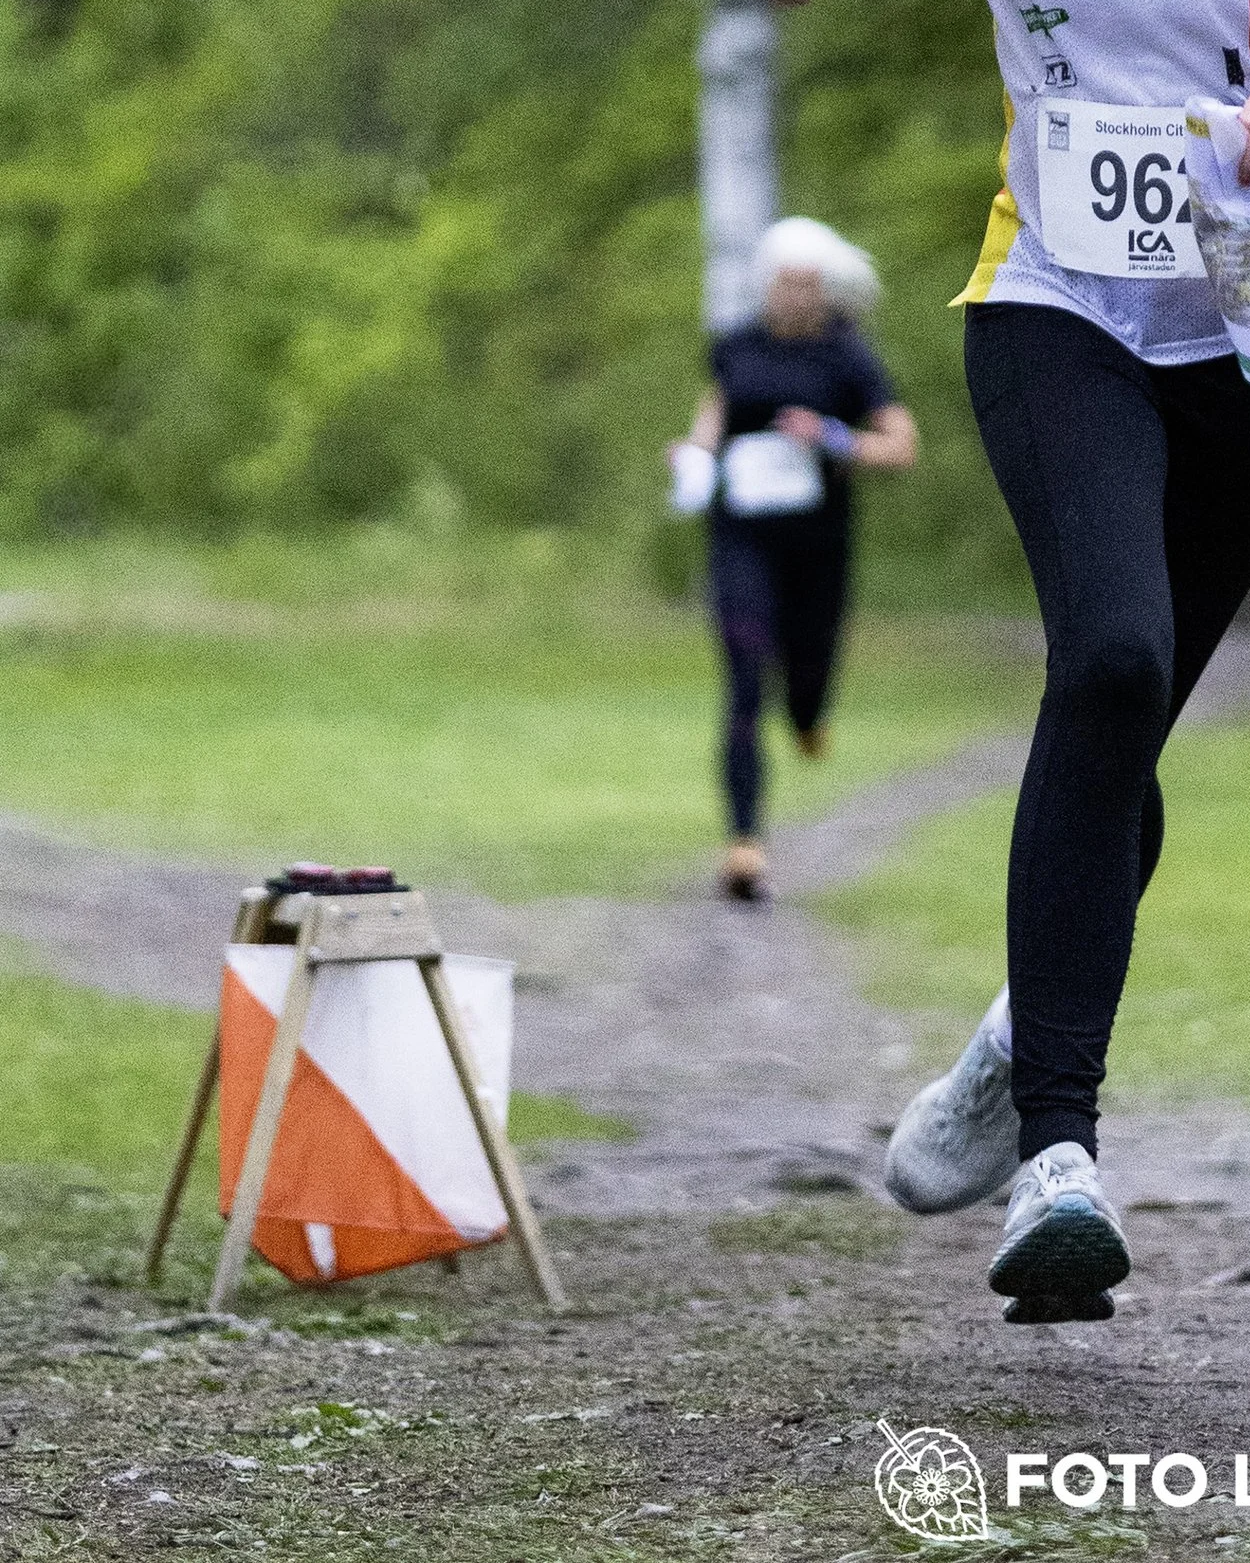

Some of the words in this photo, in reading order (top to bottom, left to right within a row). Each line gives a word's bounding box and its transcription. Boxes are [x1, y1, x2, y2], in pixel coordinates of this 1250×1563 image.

[1095, 120, 1162, 136] Stockholm
[1128, 229, 1175, 253] ICA
[1151, 252, 1176, 262] nära
